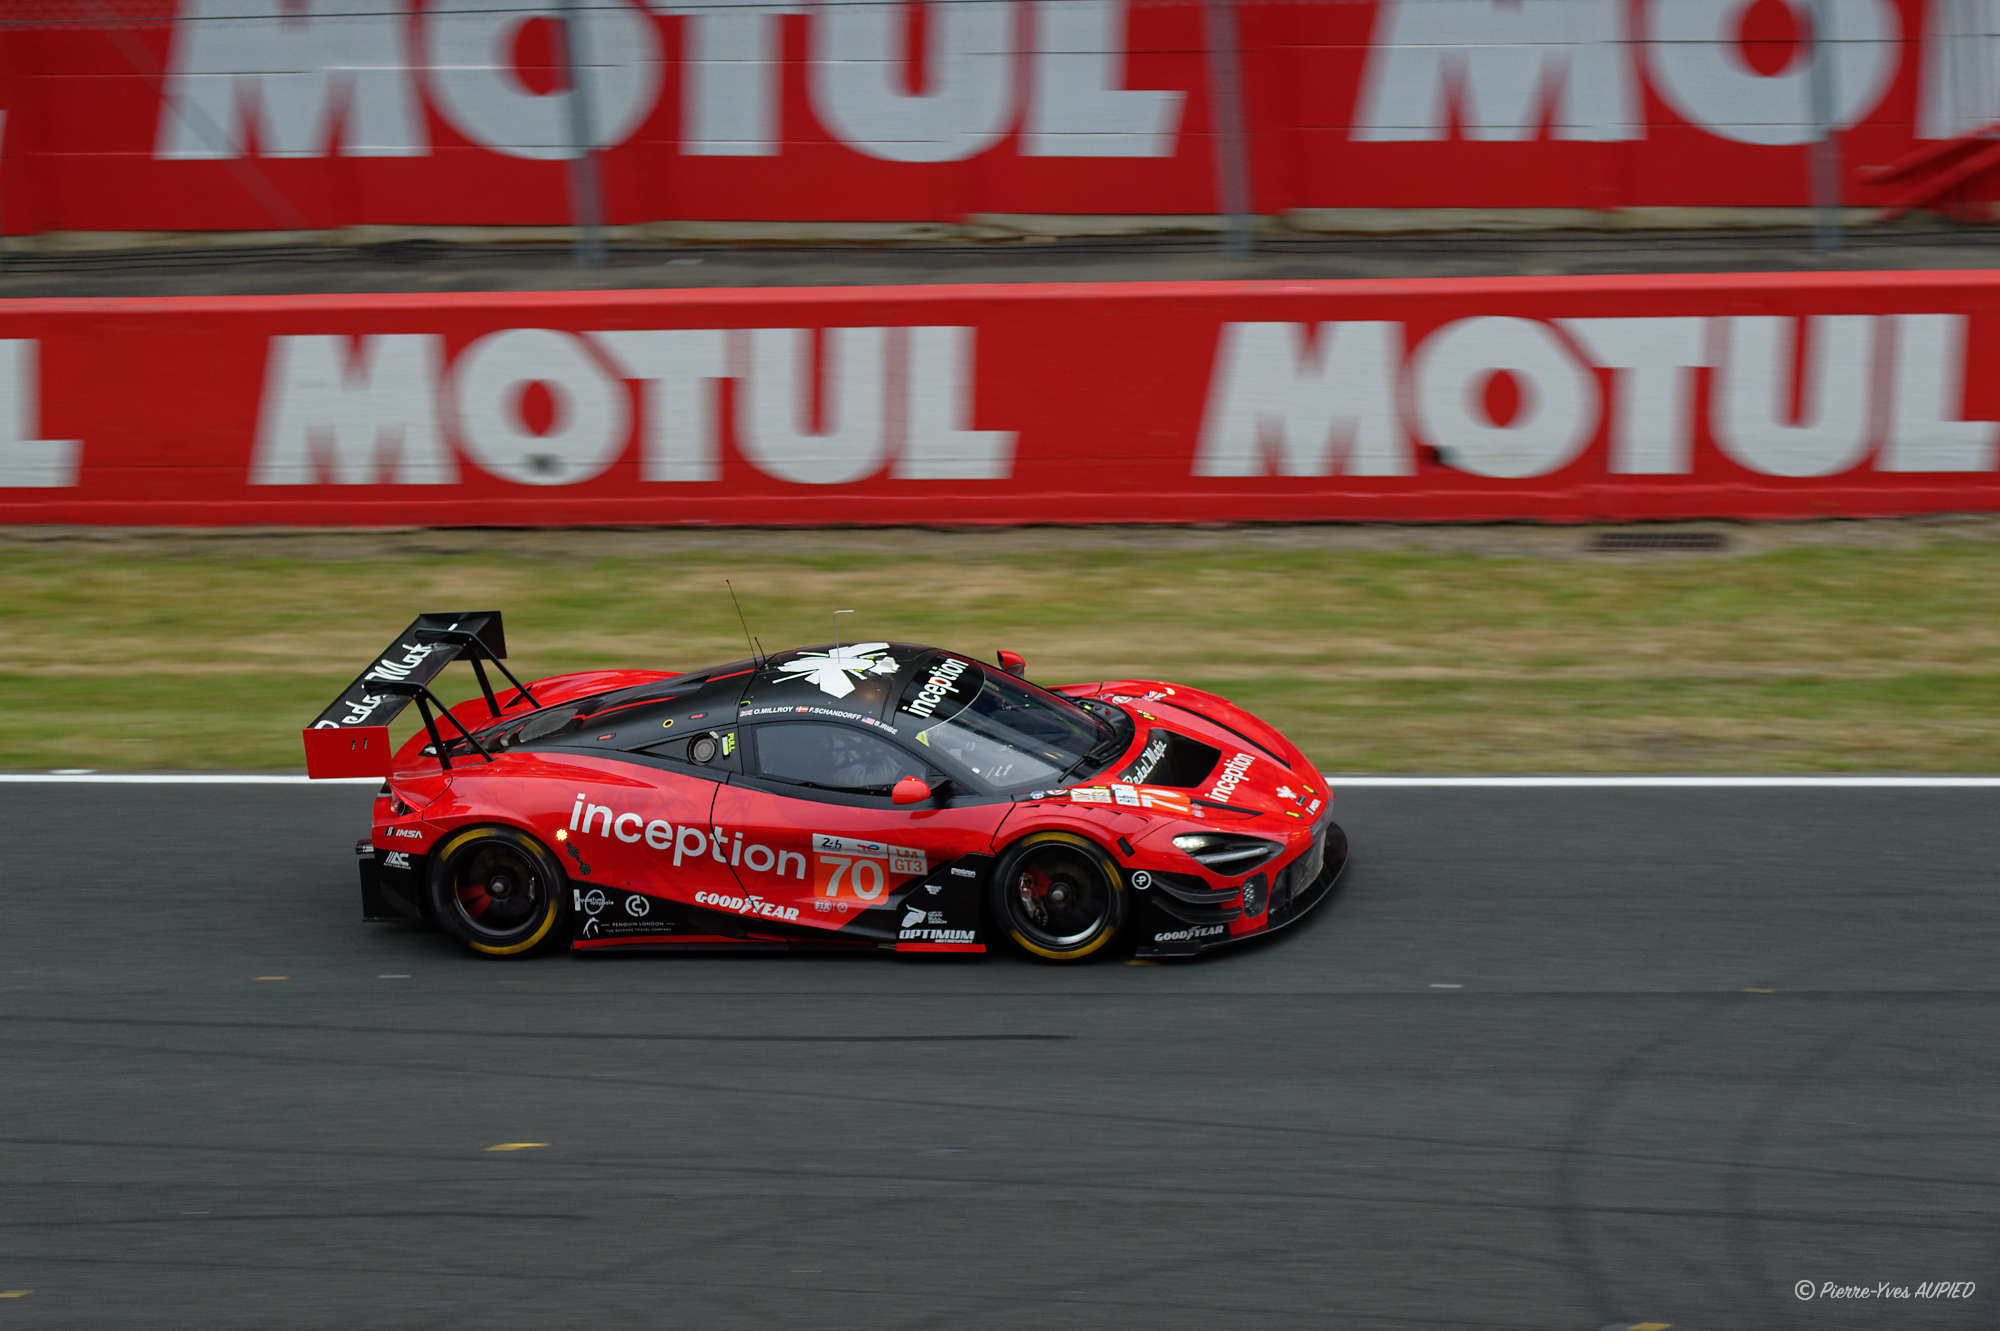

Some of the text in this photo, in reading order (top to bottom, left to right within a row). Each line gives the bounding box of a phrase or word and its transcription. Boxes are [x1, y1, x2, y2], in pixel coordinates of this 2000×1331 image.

[250, 326, 1018, 486] MOTUL
[1192, 314, 2000, 478] MOTUL
[902, 658, 969, 718] inception
[753, 706, 794, 715] O.MILLROY
[808, 706, 863, 720] F.SCHANDORFF
[1204, 752, 1256, 802] inception
[395, 829, 423, 839] IMSA
[568, 793, 807, 880] inception
[820, 855, 884, 901] 70
[894, 858, 923, 873] GT3
[694, 891, 800, 921] GOODYEAR
[898, 929, 976, 940] OPTIMUM
[1154, 925, 1225, 942] GOODYEAR
